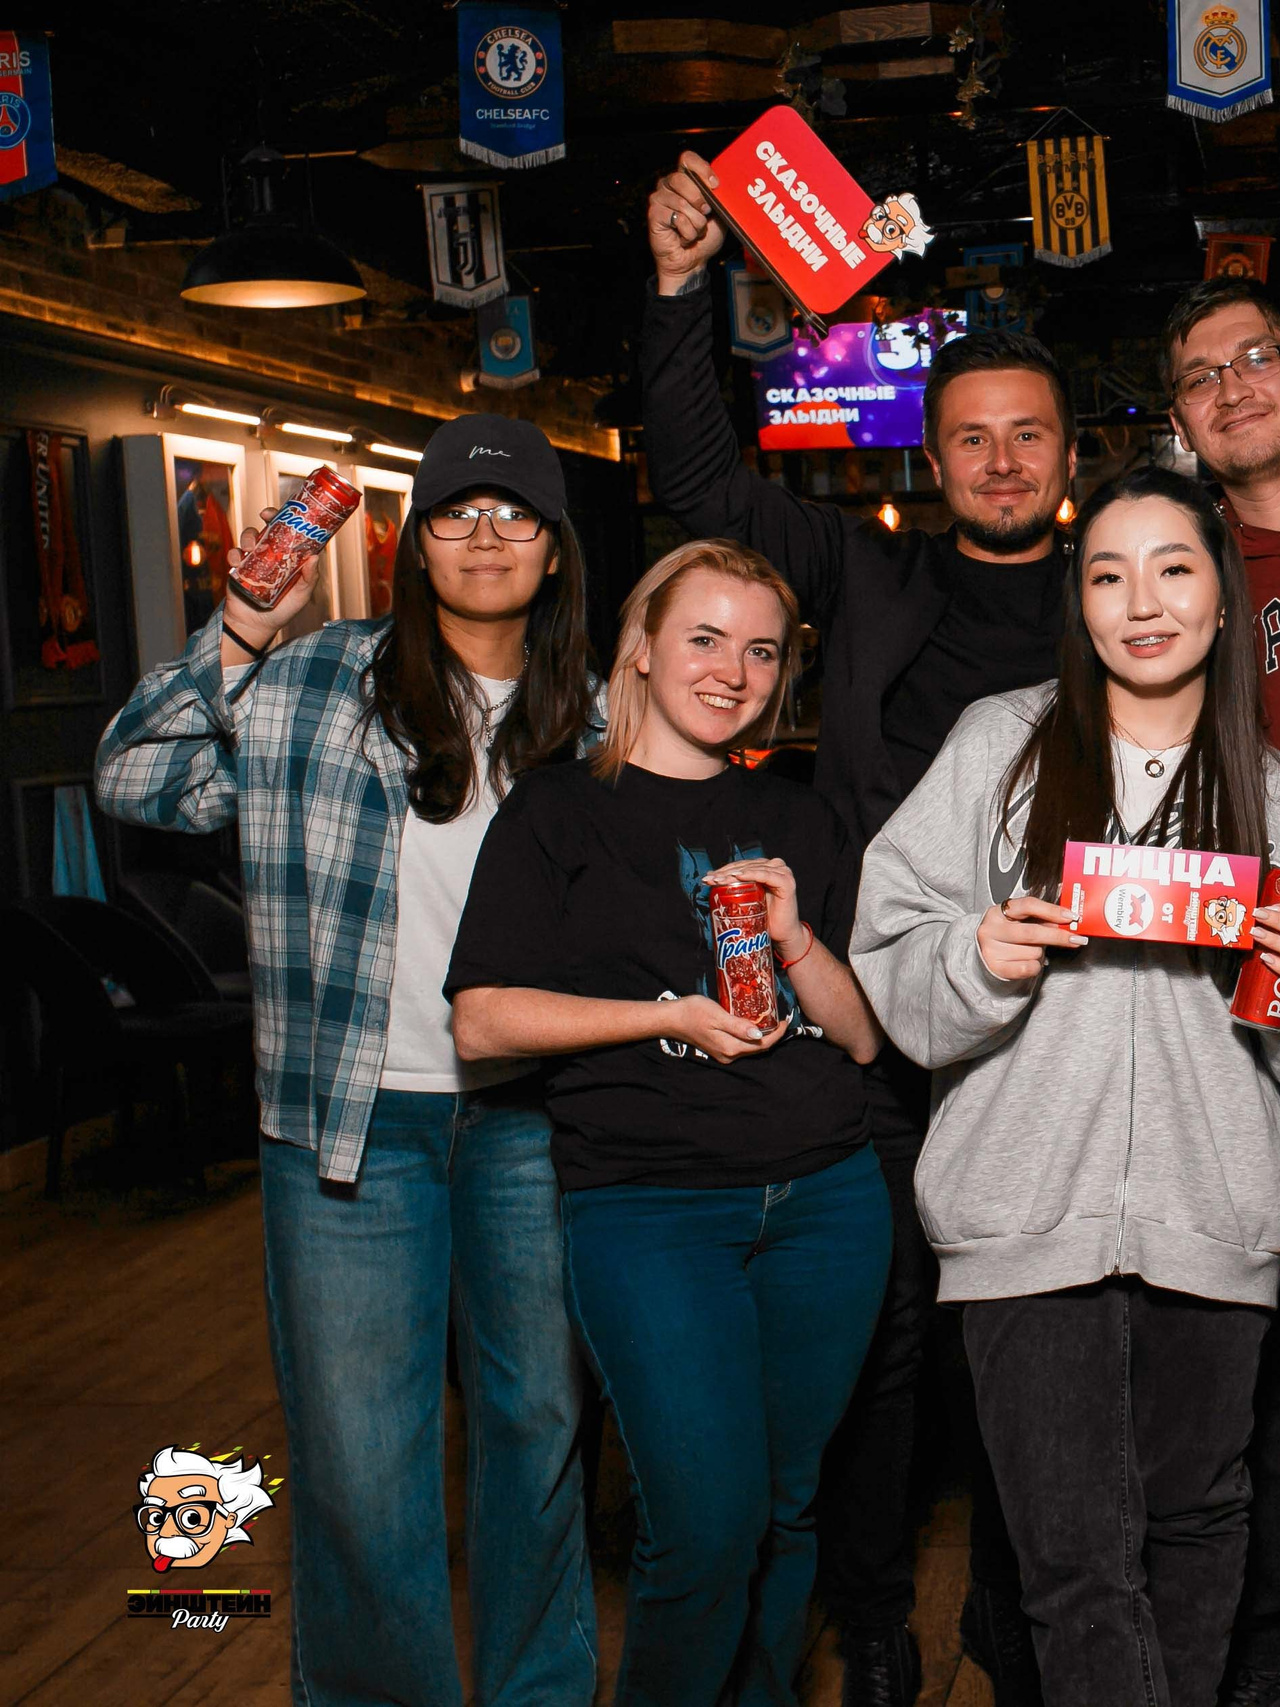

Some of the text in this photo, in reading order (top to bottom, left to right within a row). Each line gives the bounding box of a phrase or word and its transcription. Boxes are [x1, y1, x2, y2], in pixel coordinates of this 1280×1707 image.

[487, 28, 533, 46] CHELSEA
[488, 81, 536, 95] FOOTBALL CLUB
[756, 141, 867, 270] СКАЗОЧНЫЕ
[747, 178, 829, 273] ЗЛЫДНИ
[766, 386, 896, 403] СКАЗОЧНЫЕ
[768, 408, 860, 426] ЗЛЫДНИ
[1083, 846, 1236, 888] ПИЦЦА
[1115, 888, 1127, 930] Wembley
[1162, 902, 1175, 924] ОТ
